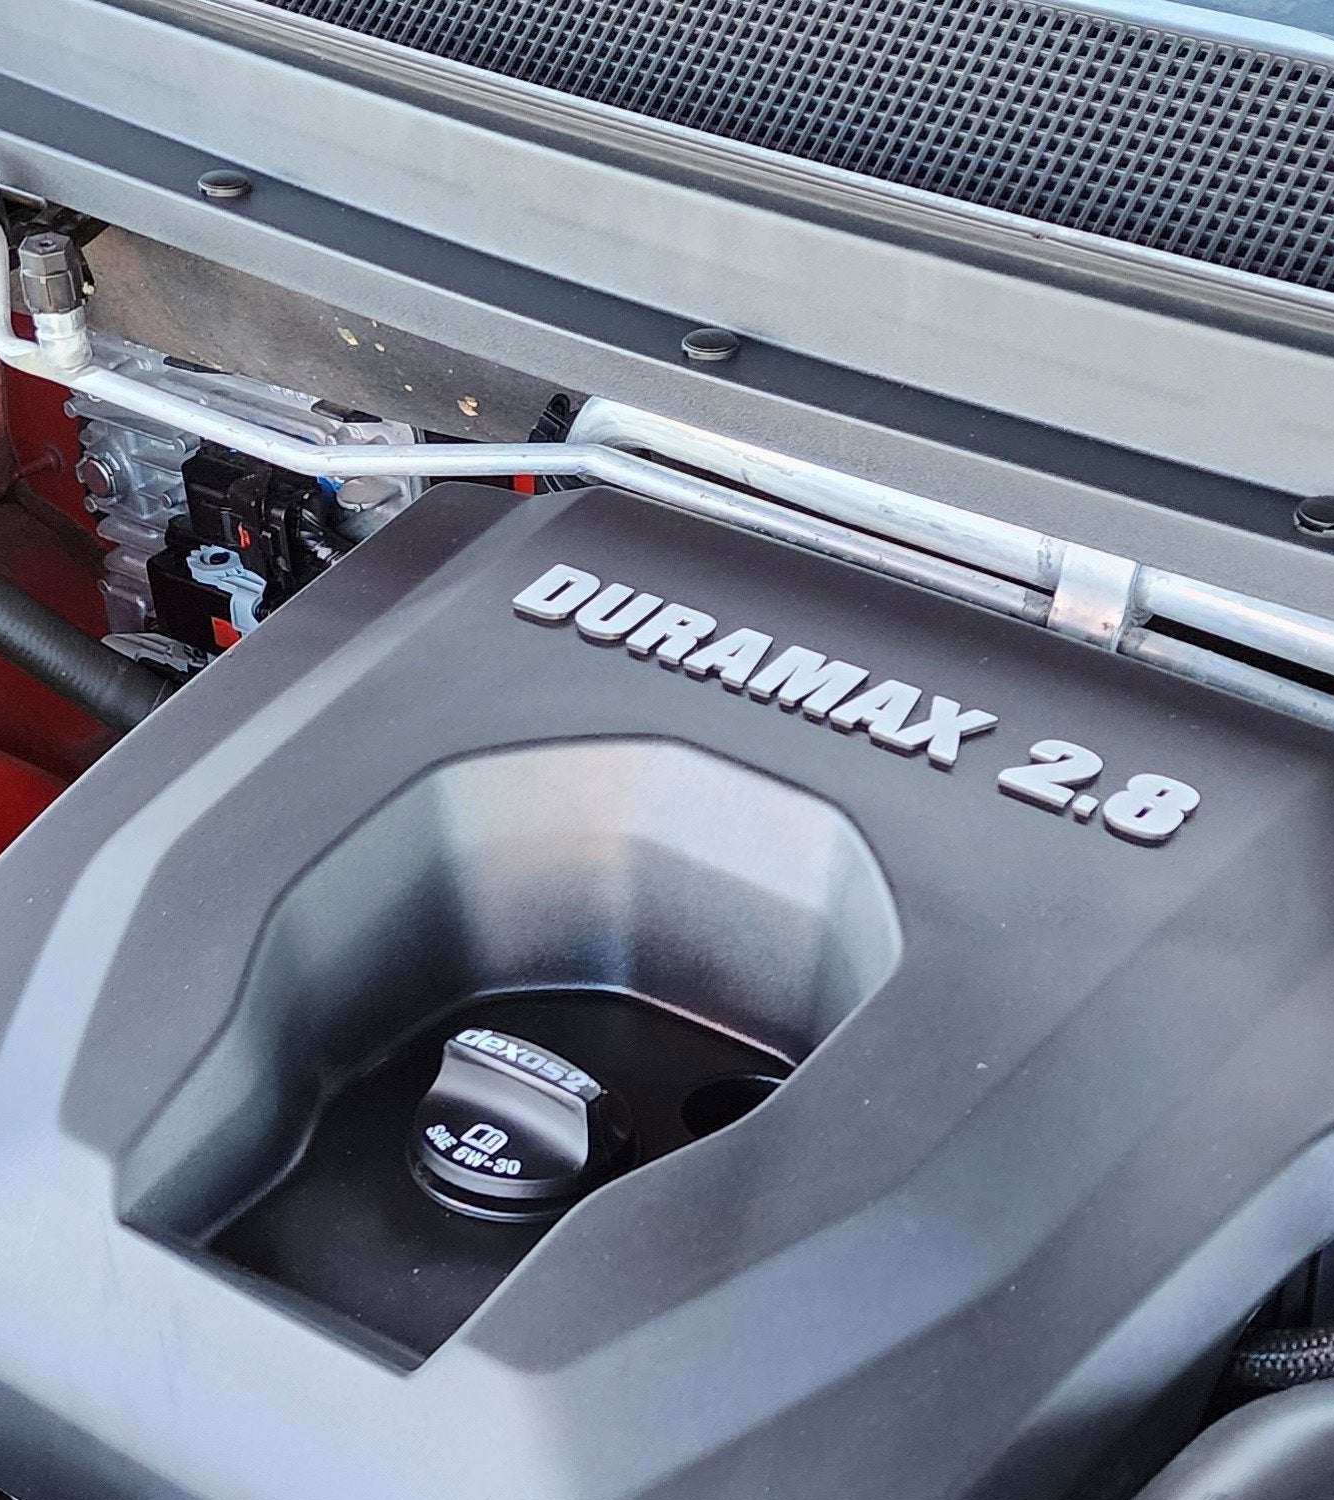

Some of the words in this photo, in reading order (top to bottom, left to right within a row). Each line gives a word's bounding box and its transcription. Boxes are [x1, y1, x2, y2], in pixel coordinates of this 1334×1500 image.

[513, 563, 999, 767] DURAMAX
[997, 739, 1201, 842] 2.8
[425, 1123, 458, 1151] SAE
[452, 1145, 522, 1175] 5W-30
